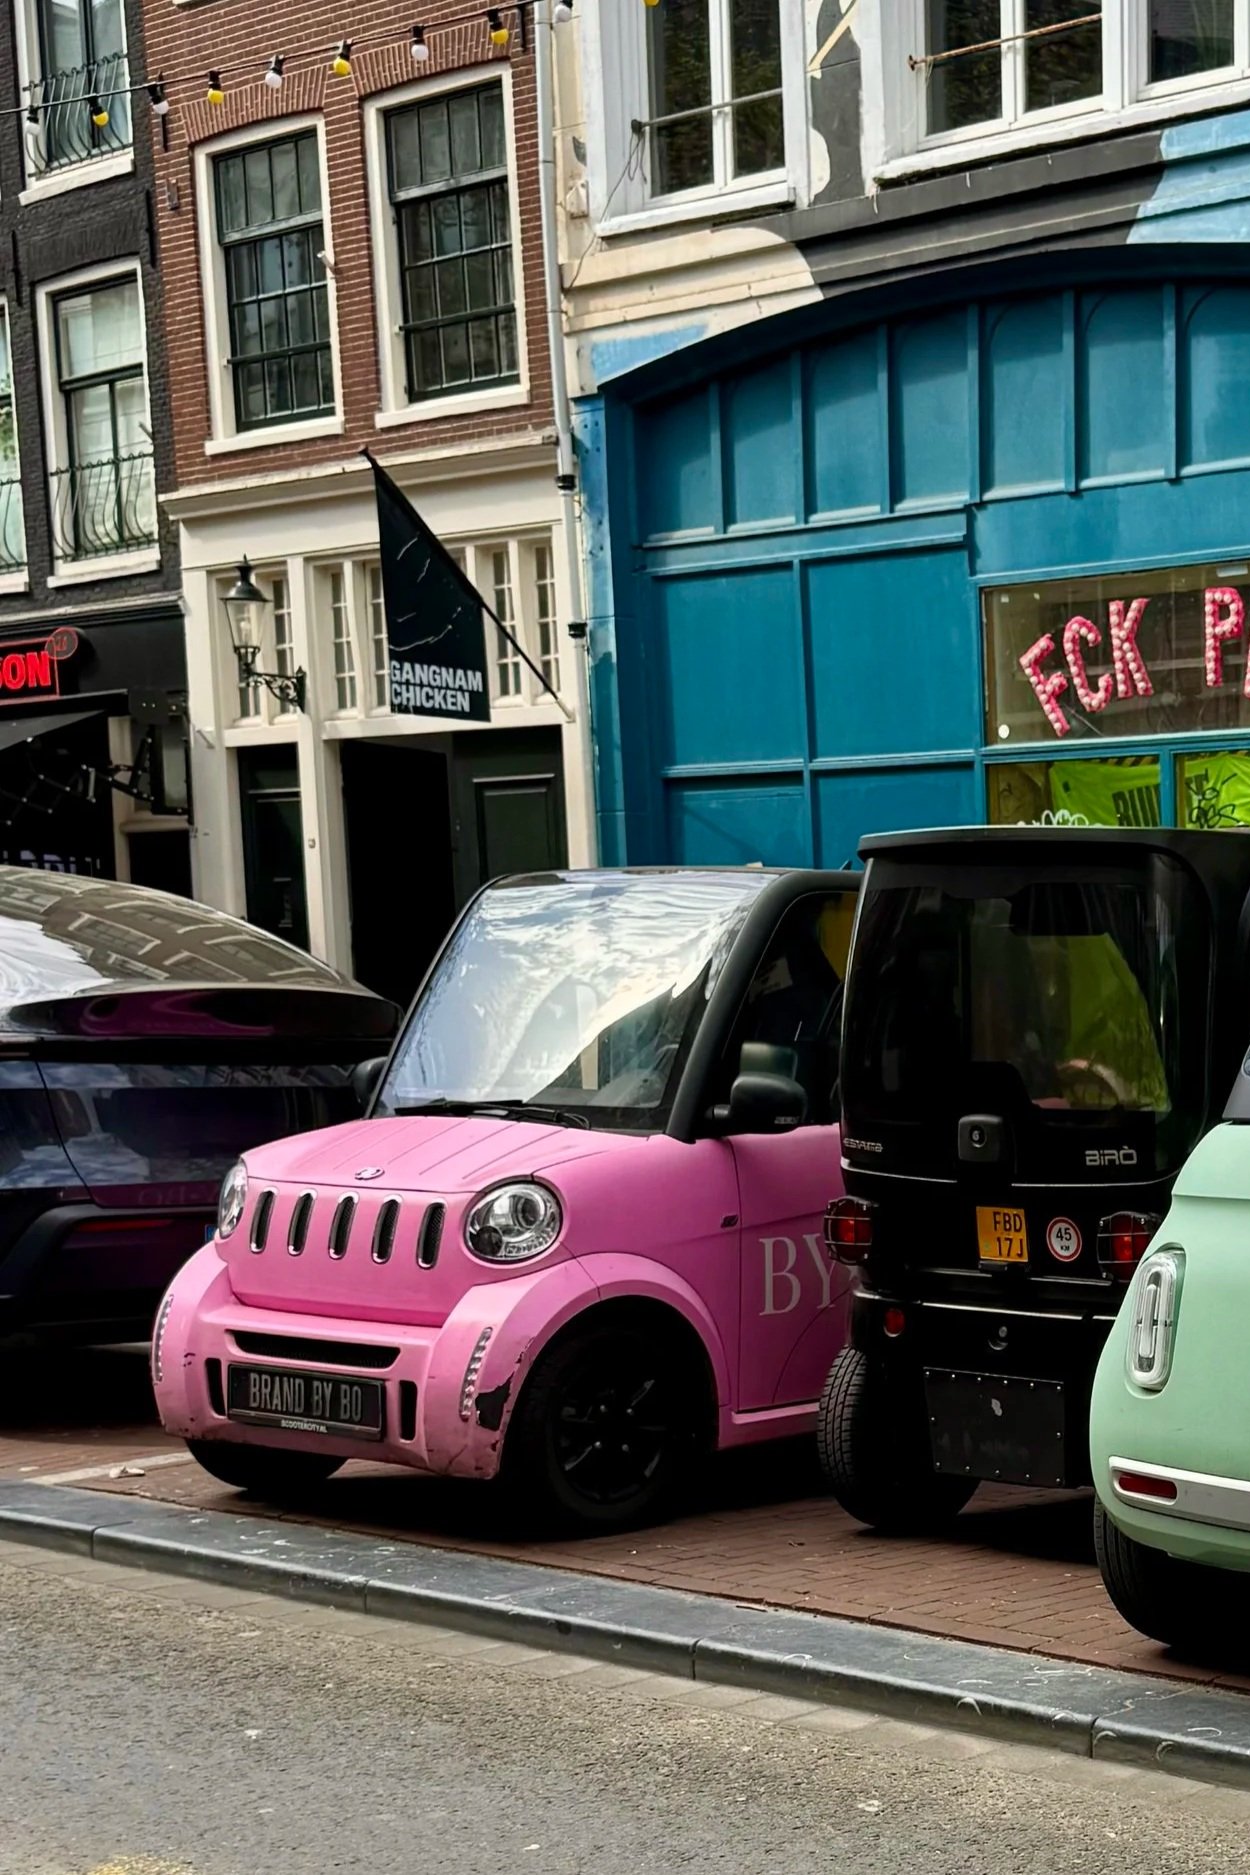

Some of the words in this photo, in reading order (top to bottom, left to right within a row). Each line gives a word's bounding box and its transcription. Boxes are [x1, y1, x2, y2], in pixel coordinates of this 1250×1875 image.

[390, 659, 483, 693] GANGNAM
[1018, 597, 1154, 738] FCK
[391, 682, 471, 713] CHICKEN
[992, 1211, 1023, 1233] FBD
[1056, 1226, 1072, 1242] 45
[996, 1236, 1024, 1258] 17J
[758, 1232, 836, 1316] BY
[249, 1372, 305, 1414] BRAND
[311, 1379, 333, 1418] BY
[340, 1384, 363, 1422] BO
